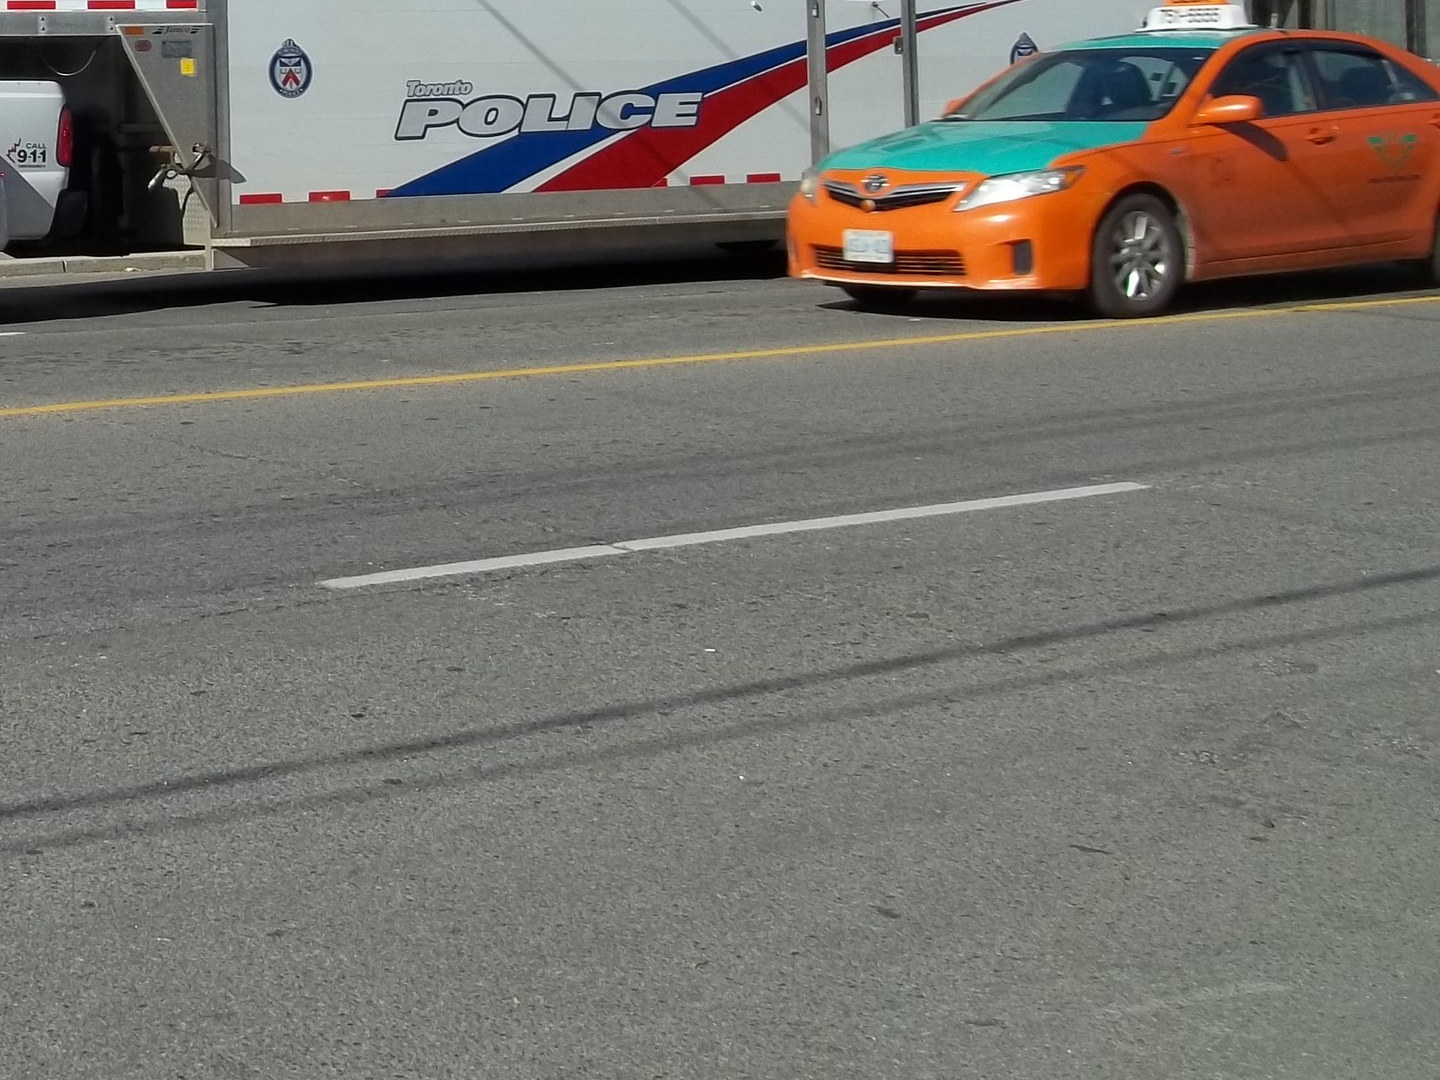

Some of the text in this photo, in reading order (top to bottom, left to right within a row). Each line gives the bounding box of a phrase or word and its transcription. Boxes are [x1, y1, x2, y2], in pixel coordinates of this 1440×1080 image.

[406, 80, 473, 97] Toronto
[394, 91, 704, 141] POLICE
[25, 142, 48, 150] CALL
[17, 149, 47, 163] 9-1-1
